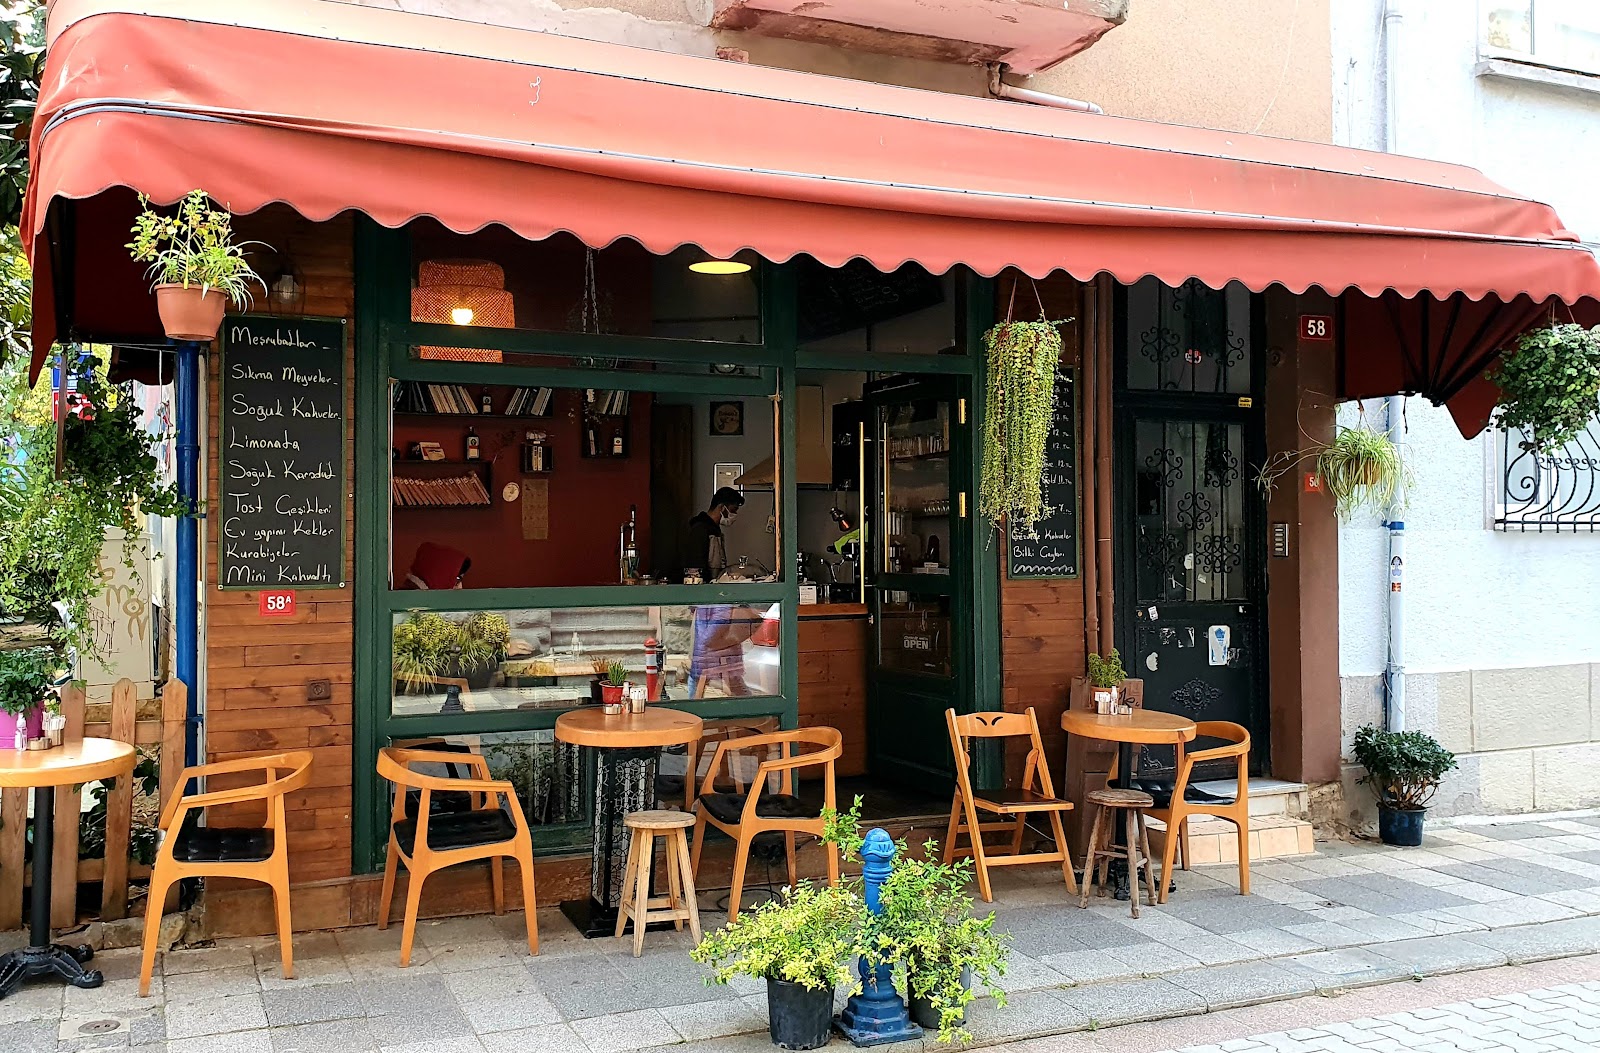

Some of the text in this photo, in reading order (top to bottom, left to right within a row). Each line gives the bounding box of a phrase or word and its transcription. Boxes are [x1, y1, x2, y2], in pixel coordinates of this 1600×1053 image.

[1307, 319, 1326, 336] 58
[232, 393, 285, 422] Soğuk
[229, 425, 301, 451] Limonata
[229, 459, 276, 487] Soğuk
[228, 492, 263, 514] Tost
[224, 516, 246, 539] Ev
[293, 519, 335, 537] Kekler
[227, 565, 266, 584] Mini
[903, 639, 929, 650] OPEN
